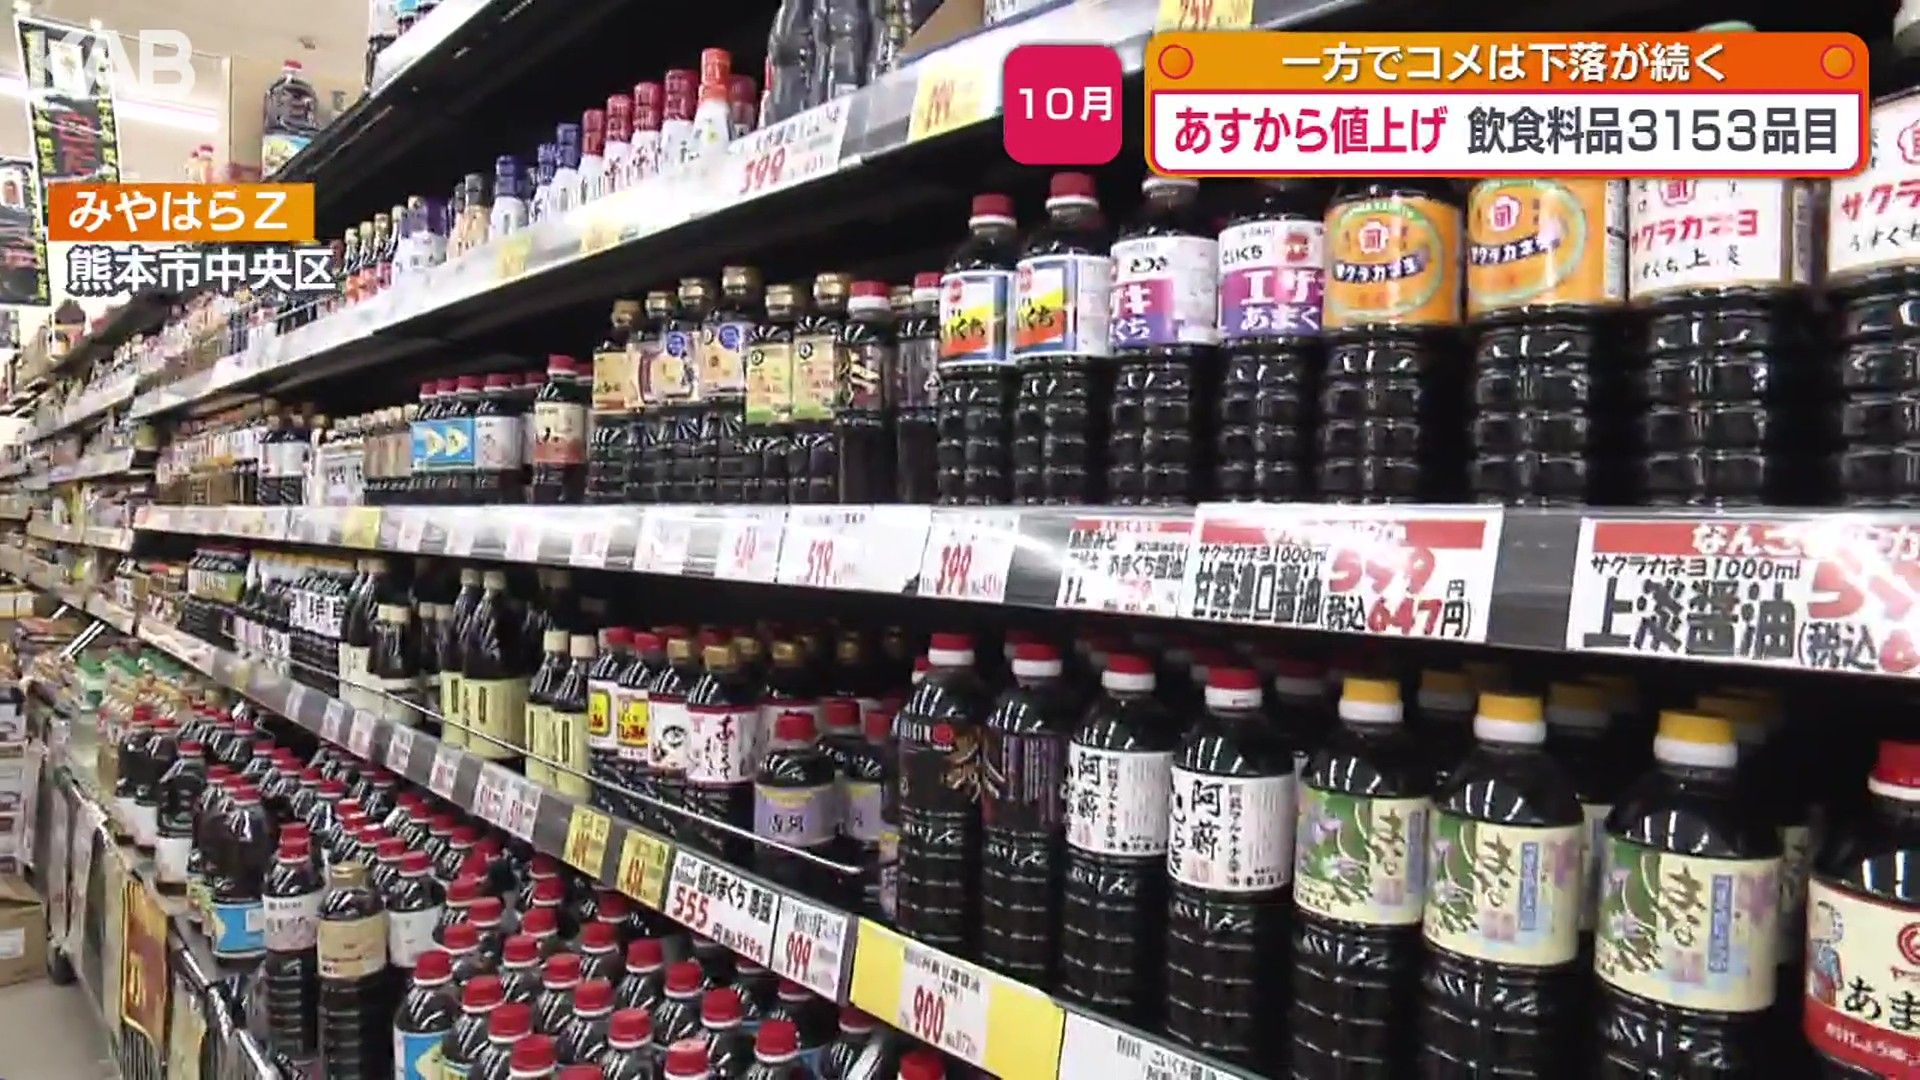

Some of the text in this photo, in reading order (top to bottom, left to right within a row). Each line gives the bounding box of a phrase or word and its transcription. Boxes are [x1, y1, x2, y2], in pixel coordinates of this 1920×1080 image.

[1447, 579, 1466, 597] 円
[1590, 555, 1800, 580] サクラカネヨ1000ml
[1583, 575, 1797, 661] 上淡醤油
[673, 886, 709, 929] 555
[913, 984, 946, 1045] 900
